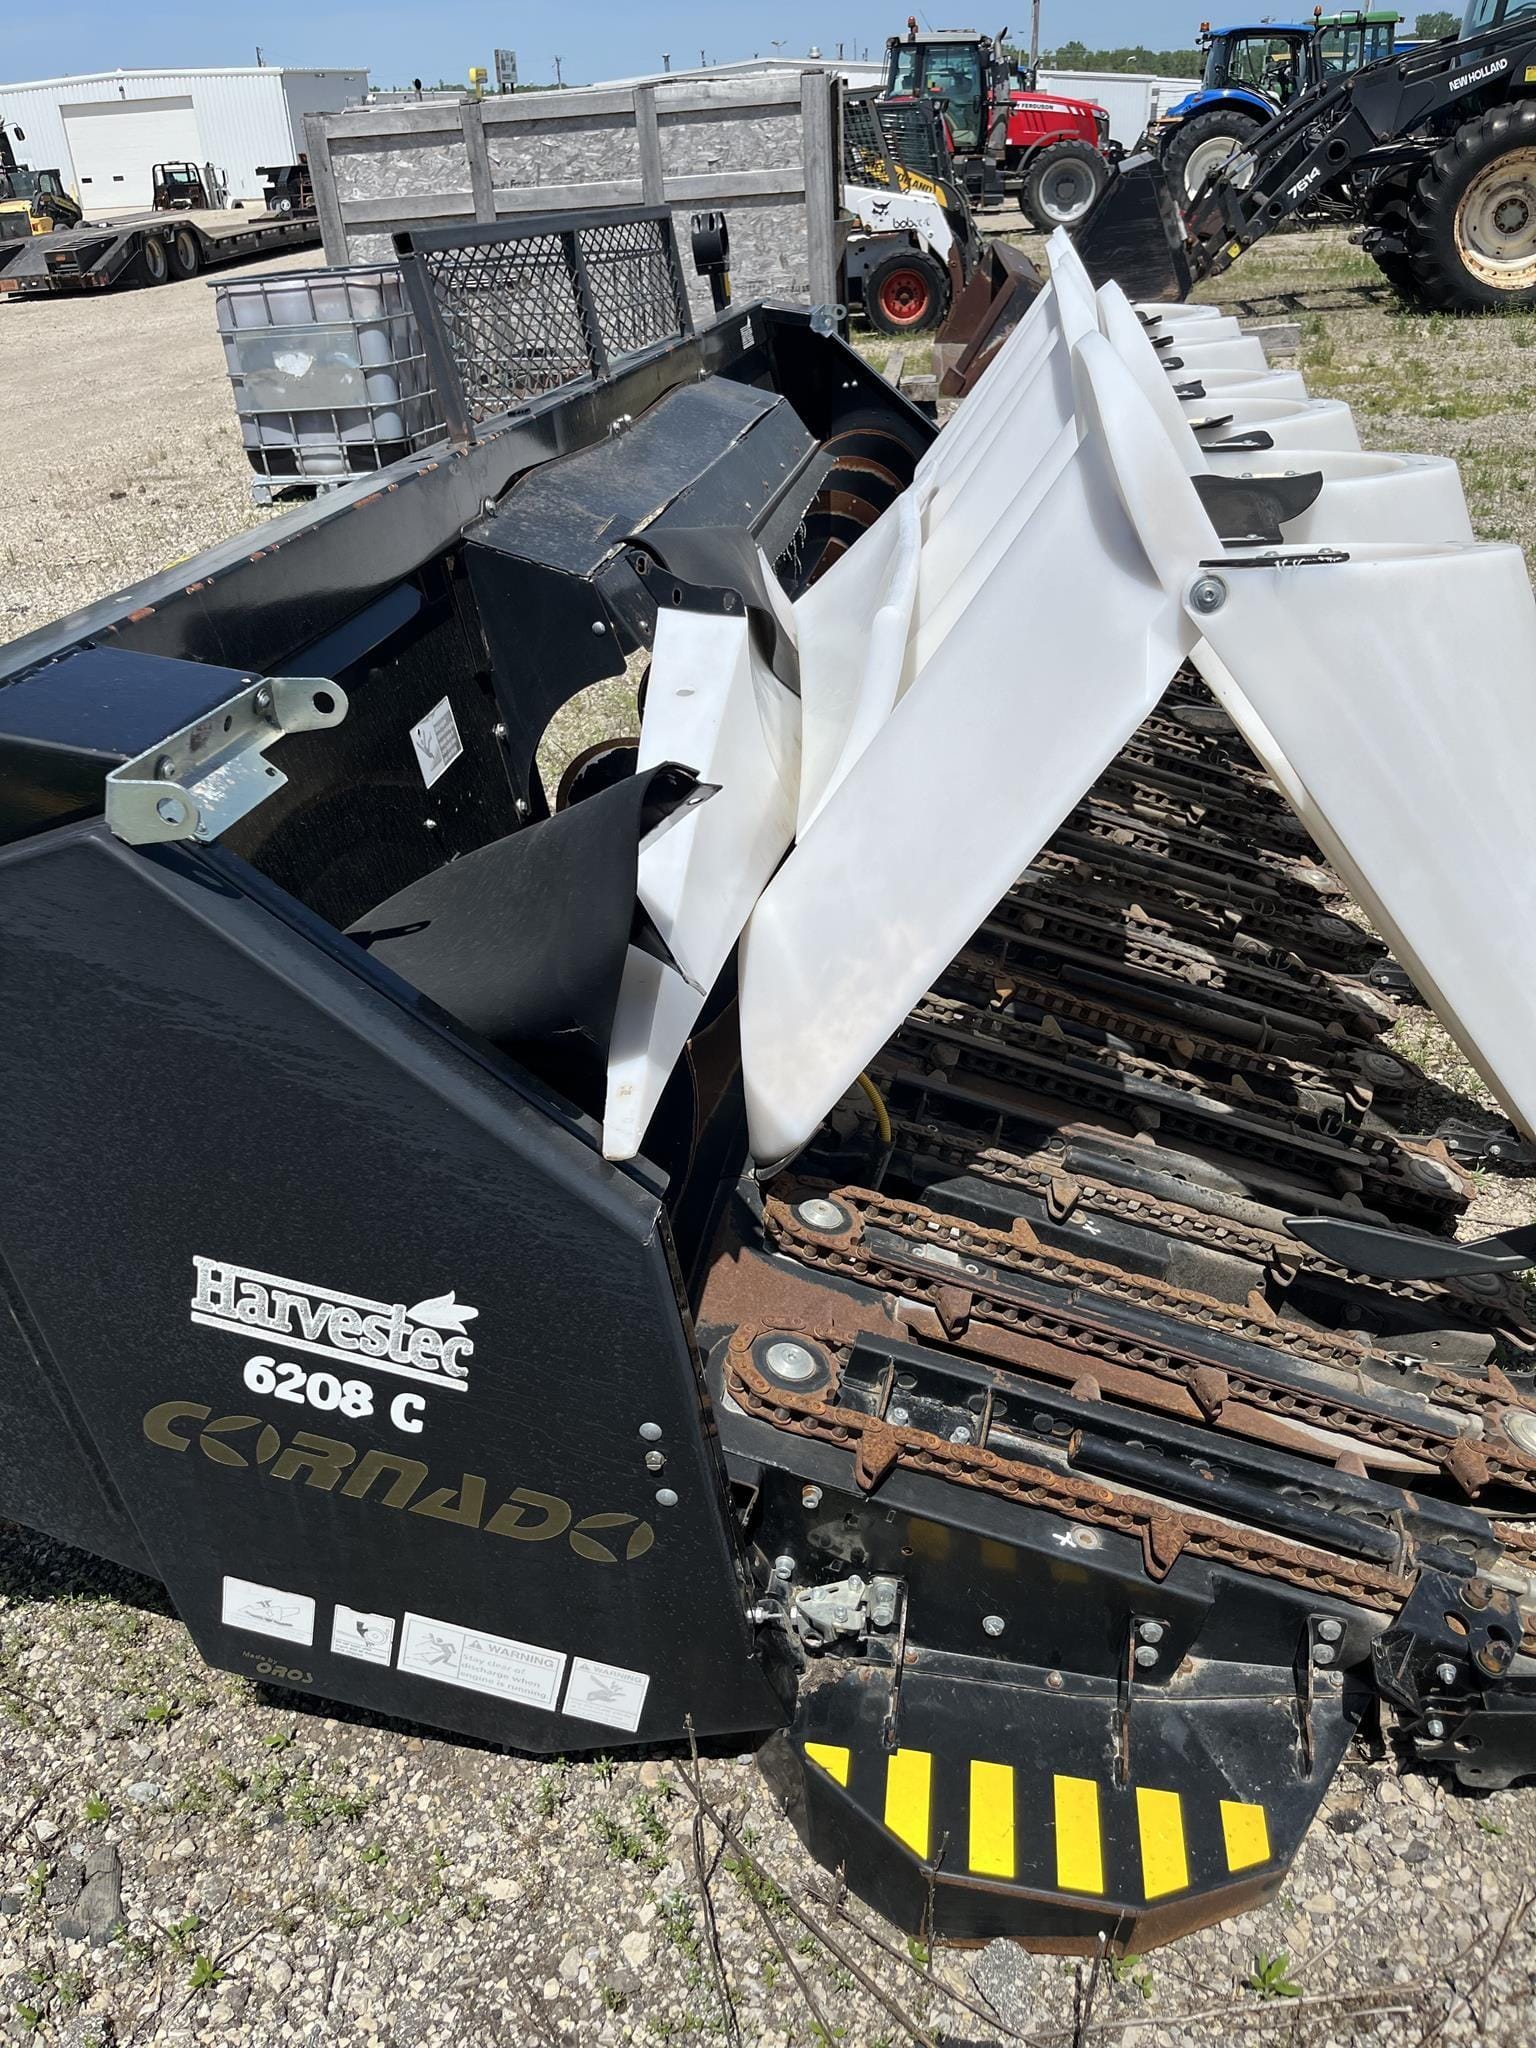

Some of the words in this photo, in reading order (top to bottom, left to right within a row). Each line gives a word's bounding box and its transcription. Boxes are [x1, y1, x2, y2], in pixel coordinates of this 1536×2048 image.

[1448, 74, 1468, 92] NEW
[1467, 58, 1508, 83] HOLLAND
[1286, 166, 1321, 199] 7614
[191, 1255, 474, 1378] Harvestec
[243, 1355, 374, 1418] 6208
[390, 1392, 426, 1434] C
[242, 1650, 266, 1661] Made
[487, 1660, 512, 1671] clear
[488, 1643, 554, 1668] WARNING
[460, 1671, 495, 1684] engine
[461, 1662, 510, 1680] discharge
[511, 1676, 541, 1689] when
[593, 1665, 643, 1684] WARNING
